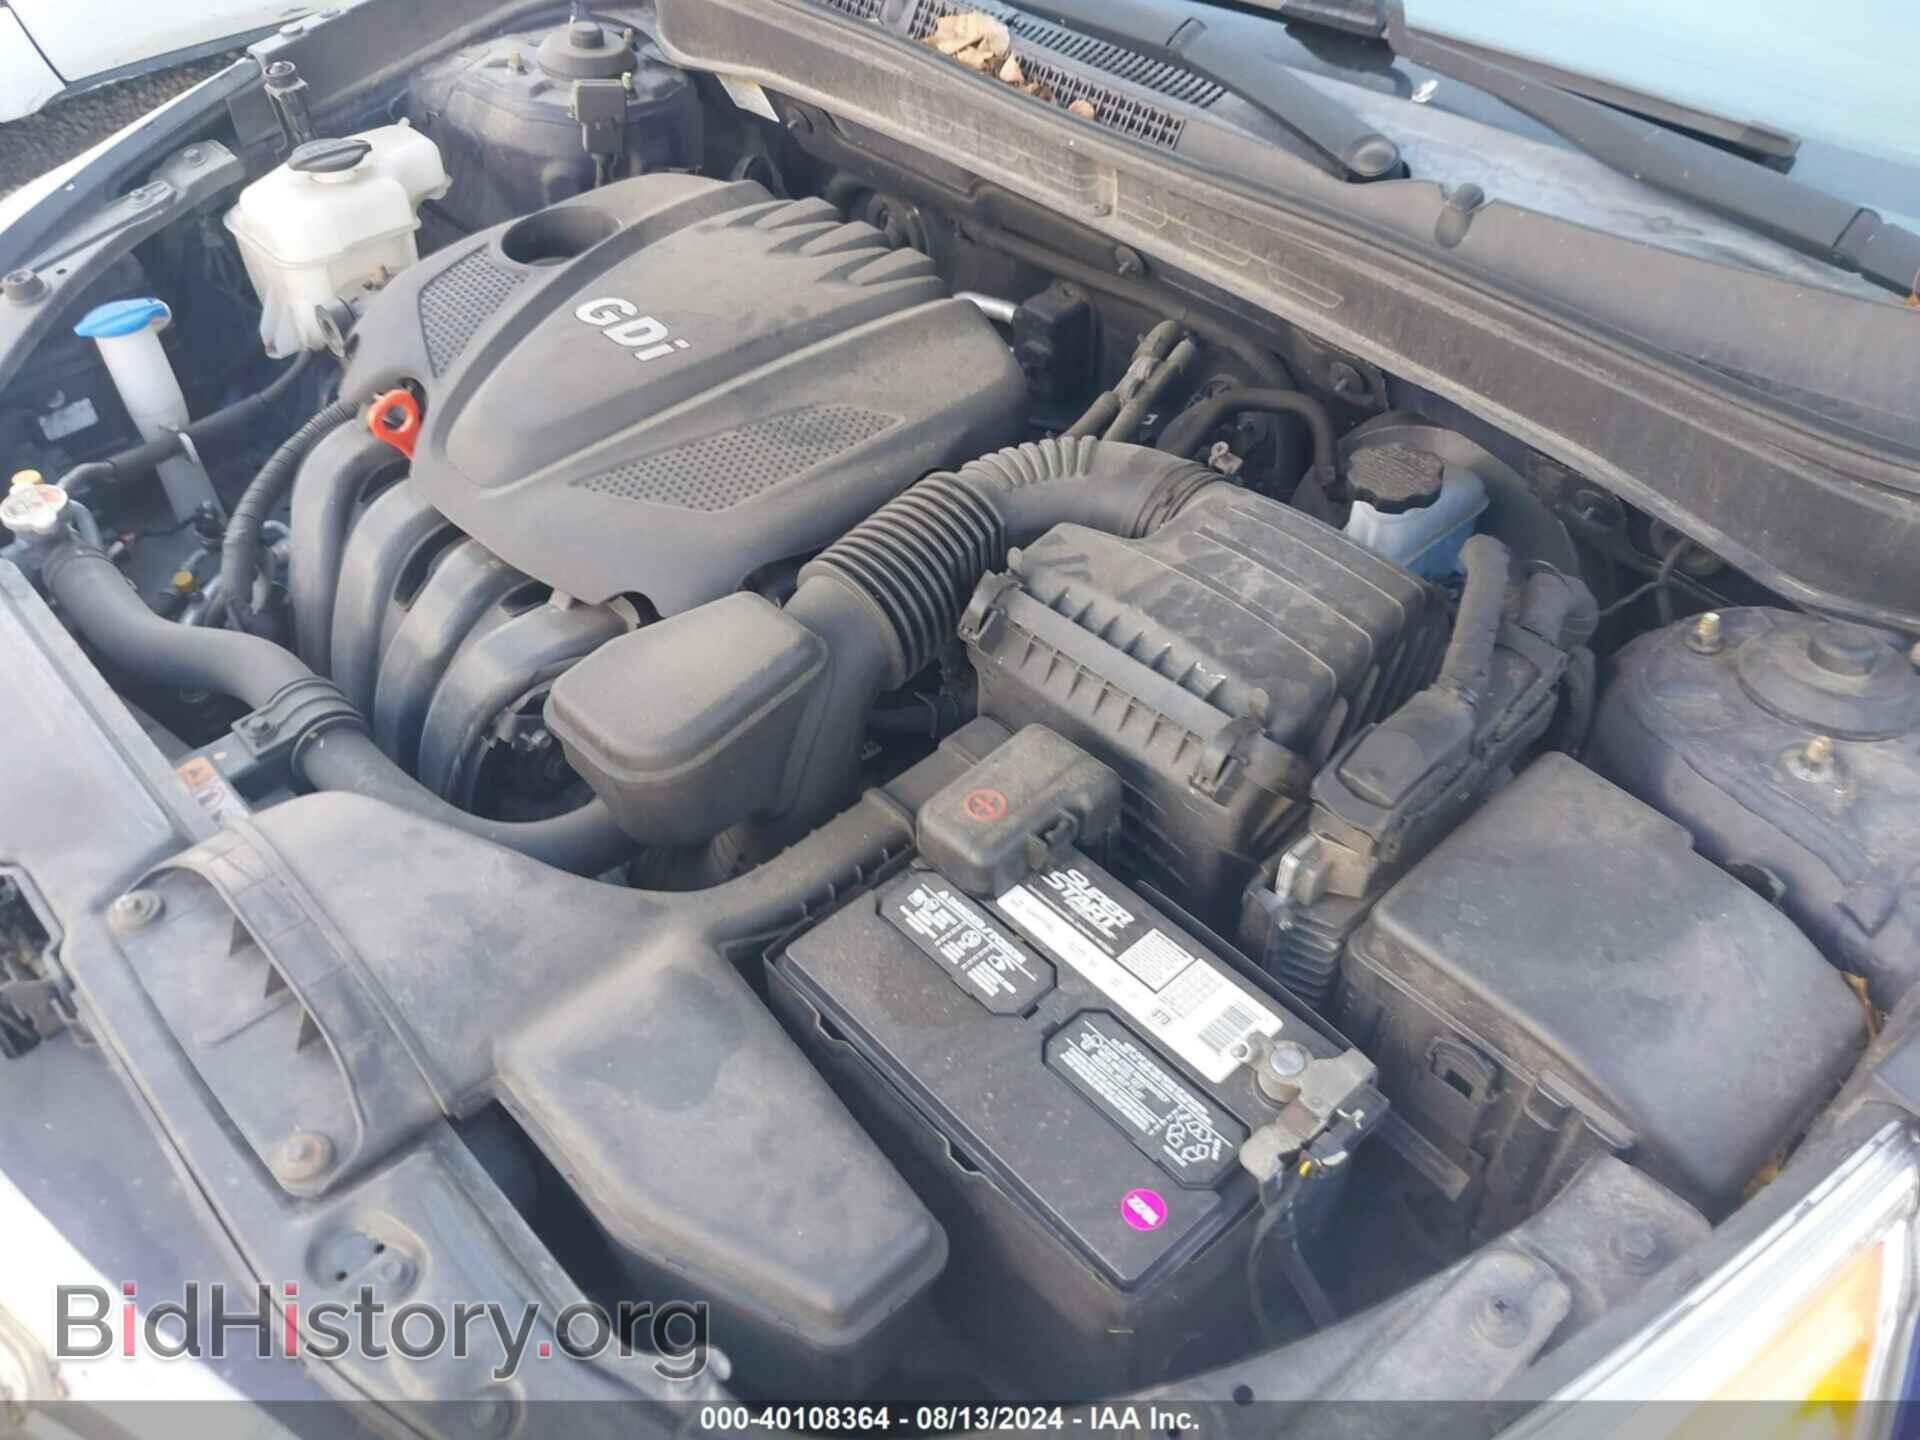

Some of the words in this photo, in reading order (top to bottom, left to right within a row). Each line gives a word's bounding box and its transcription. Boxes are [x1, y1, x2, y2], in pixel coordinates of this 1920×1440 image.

[575, 298, 690, 361] GDi
[1039, 870, 1125, 930] START
[1065, 868, 1136, 927] SUPER
